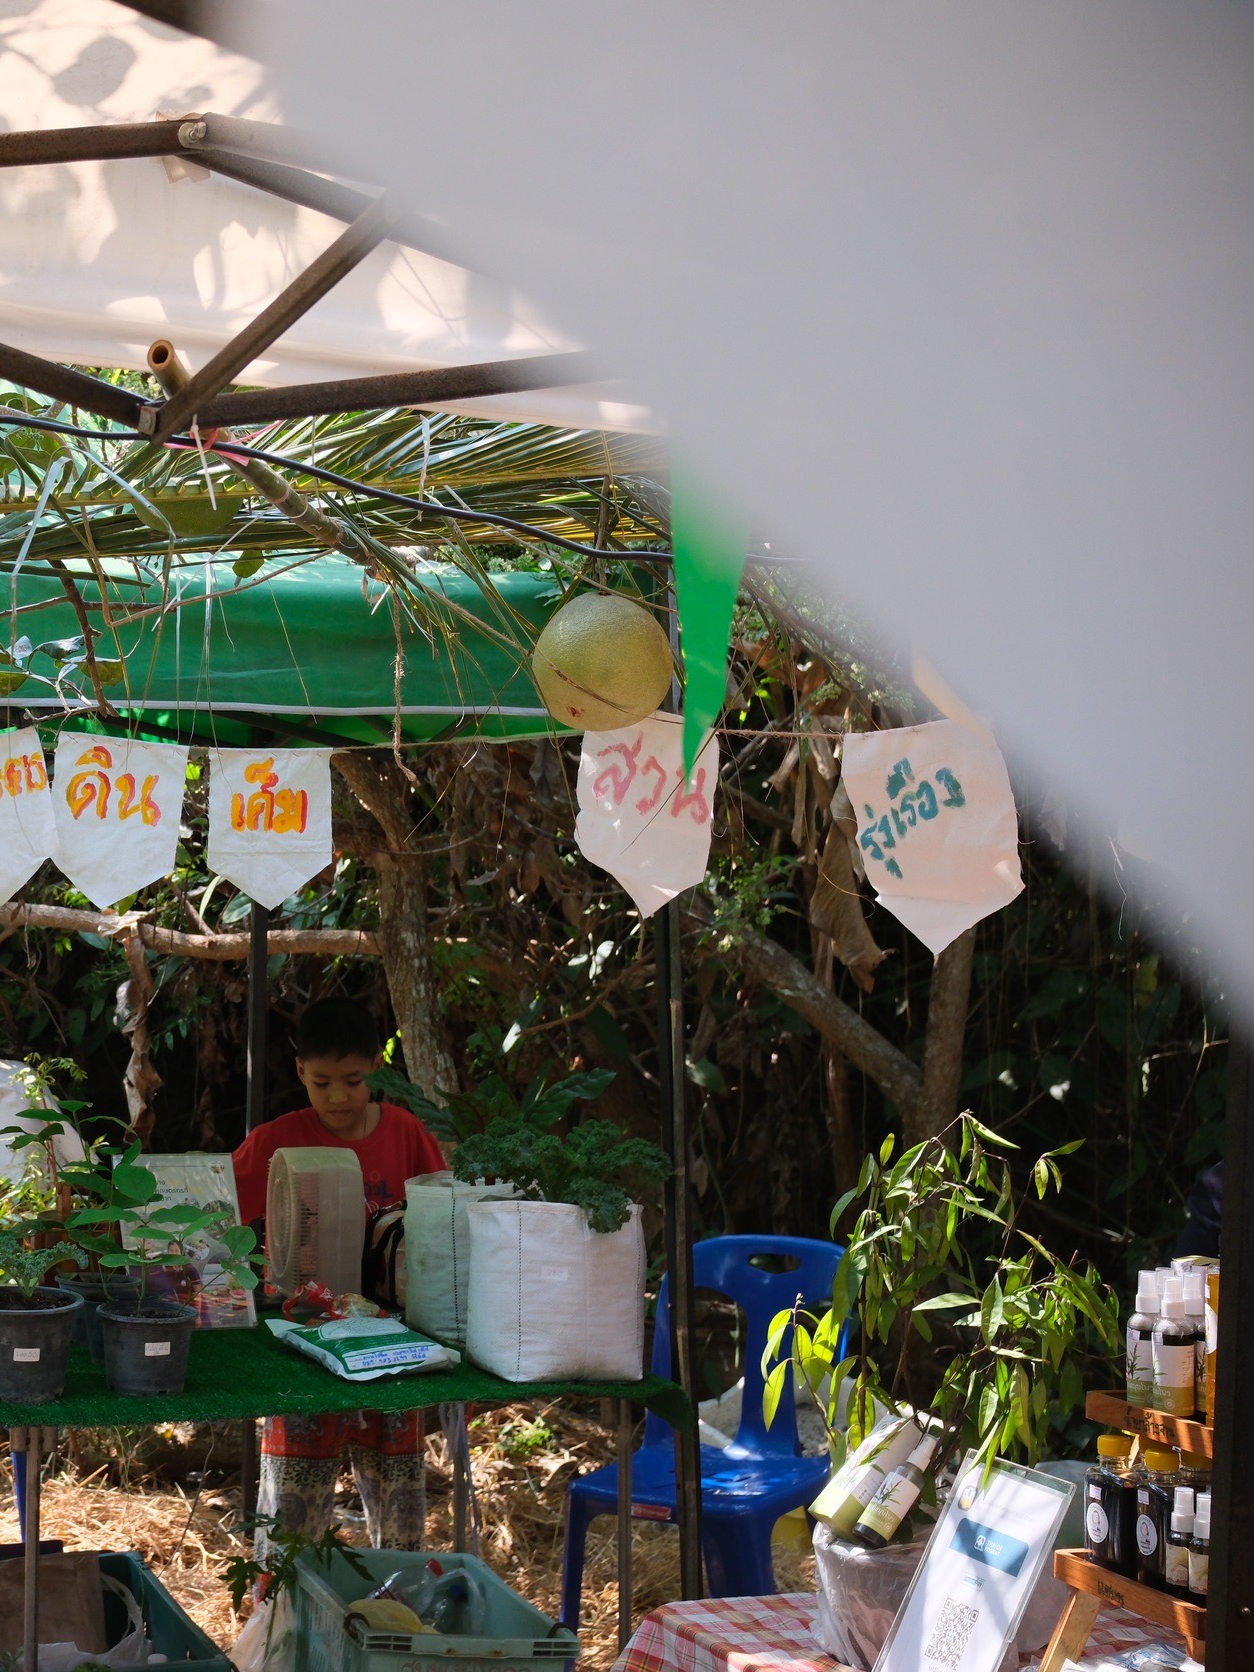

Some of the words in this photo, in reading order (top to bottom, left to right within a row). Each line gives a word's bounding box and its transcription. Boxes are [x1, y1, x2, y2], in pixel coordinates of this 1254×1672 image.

[65, 745, 162, 828] ดิน
[231, 756, 308, 834] เค็ม
[592, 729, 710, 825] สวน
